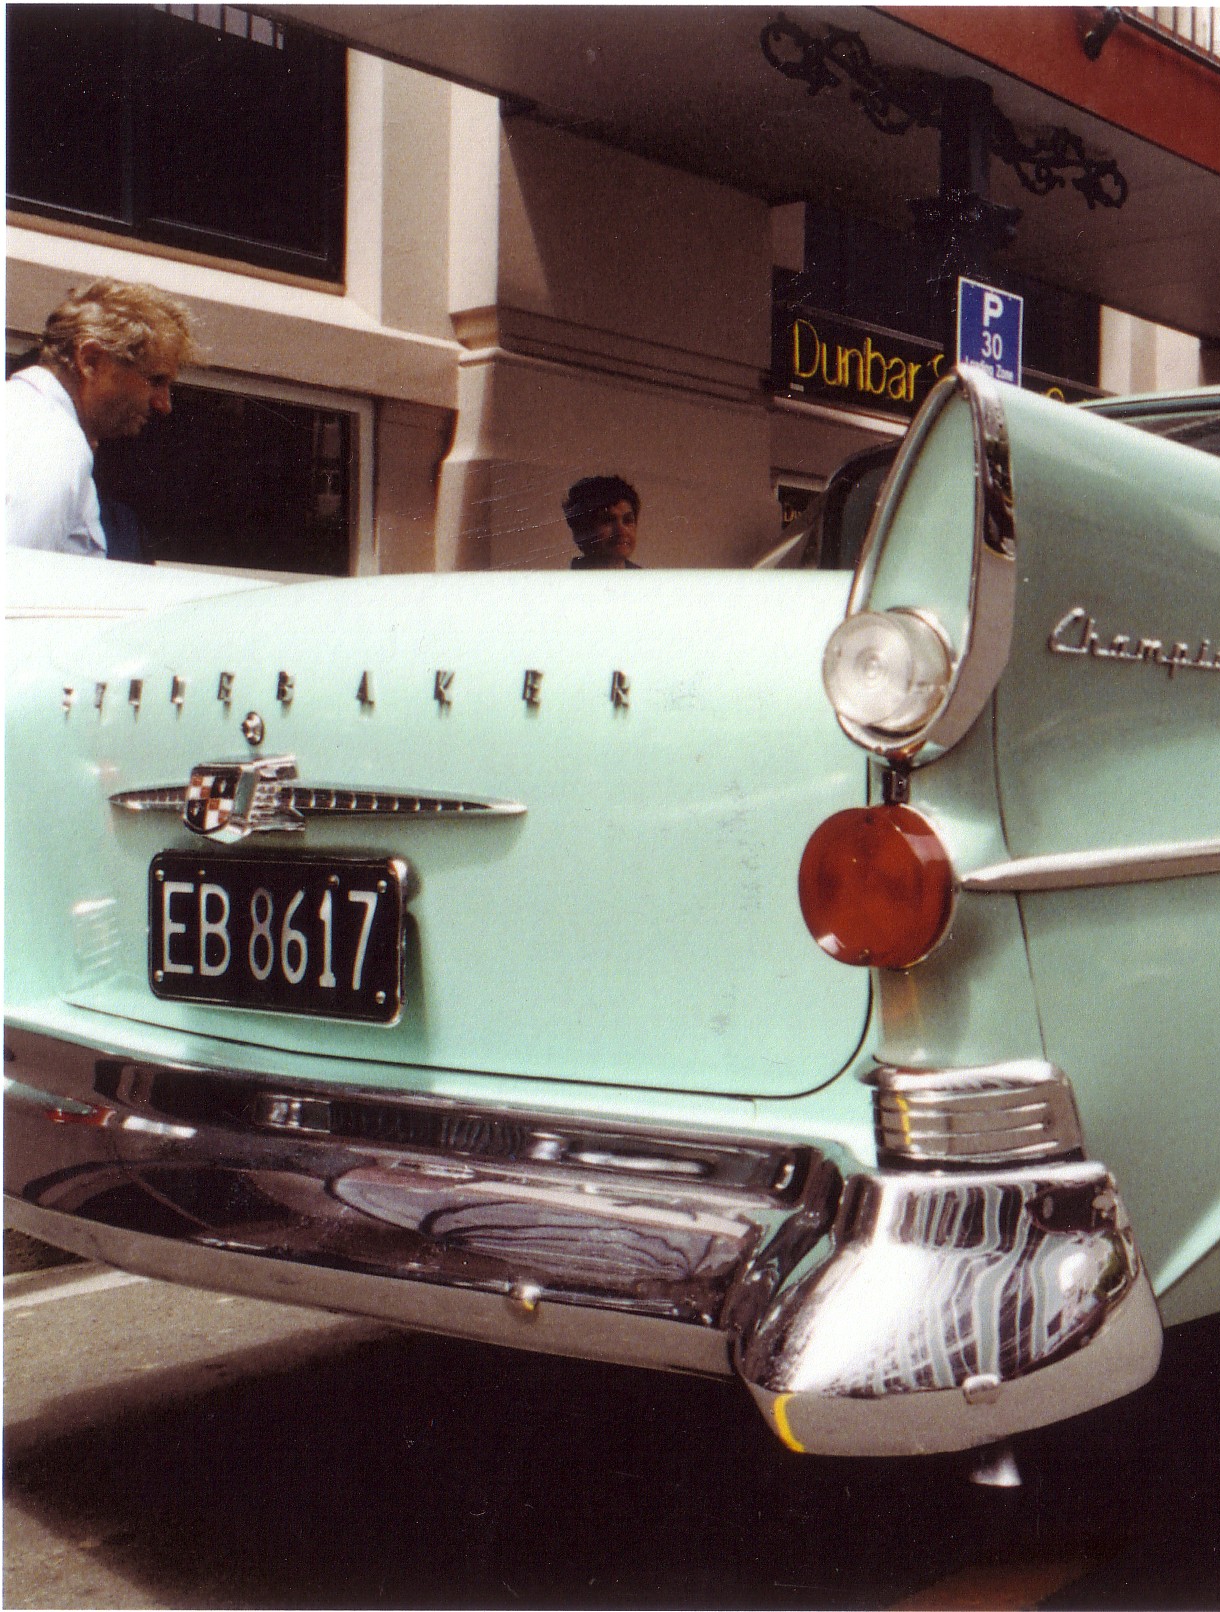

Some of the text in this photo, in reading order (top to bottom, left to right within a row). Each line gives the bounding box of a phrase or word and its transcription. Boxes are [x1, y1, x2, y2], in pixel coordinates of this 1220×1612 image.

[983, 291, 1004, 327] P
[981, 330, 1003, 360] 30
[163, 881, 379, 991] EB 8617
